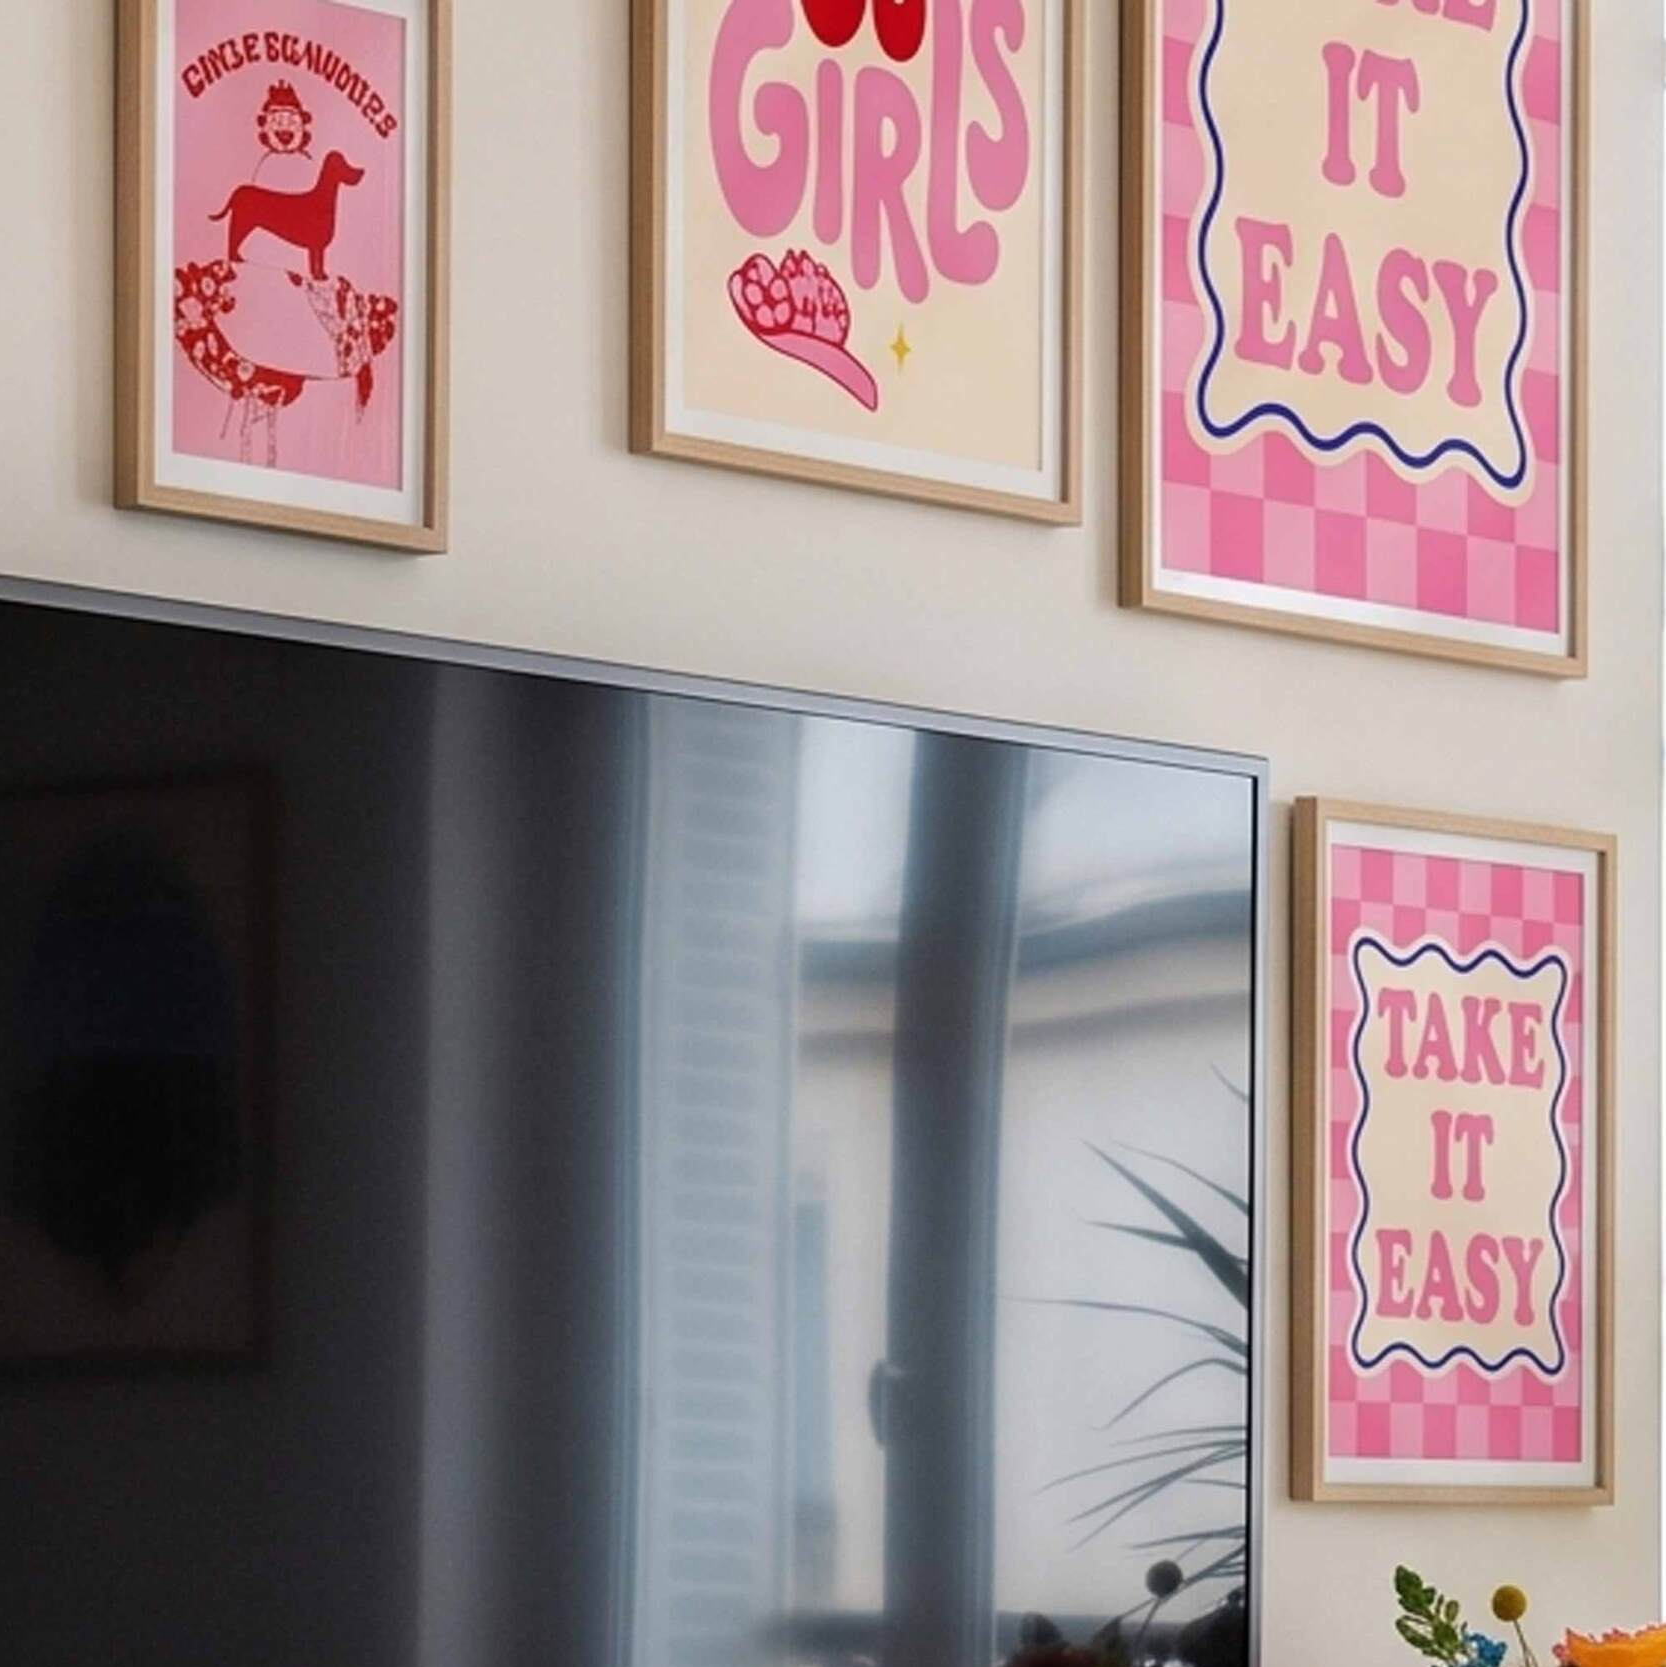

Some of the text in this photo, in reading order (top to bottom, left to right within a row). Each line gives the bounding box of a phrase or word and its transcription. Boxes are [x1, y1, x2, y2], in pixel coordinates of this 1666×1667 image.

[709, 0, 1029, 304] GIRLS
[1322, 41, 1420, 198] IT
[1234, 216, 1498, 408] EASY
[1377, 987, 1546, 1090] TAKE
[1431, 1110, 1495, 1202] IT
[1374, 1228, 1544, 1327] EASY
